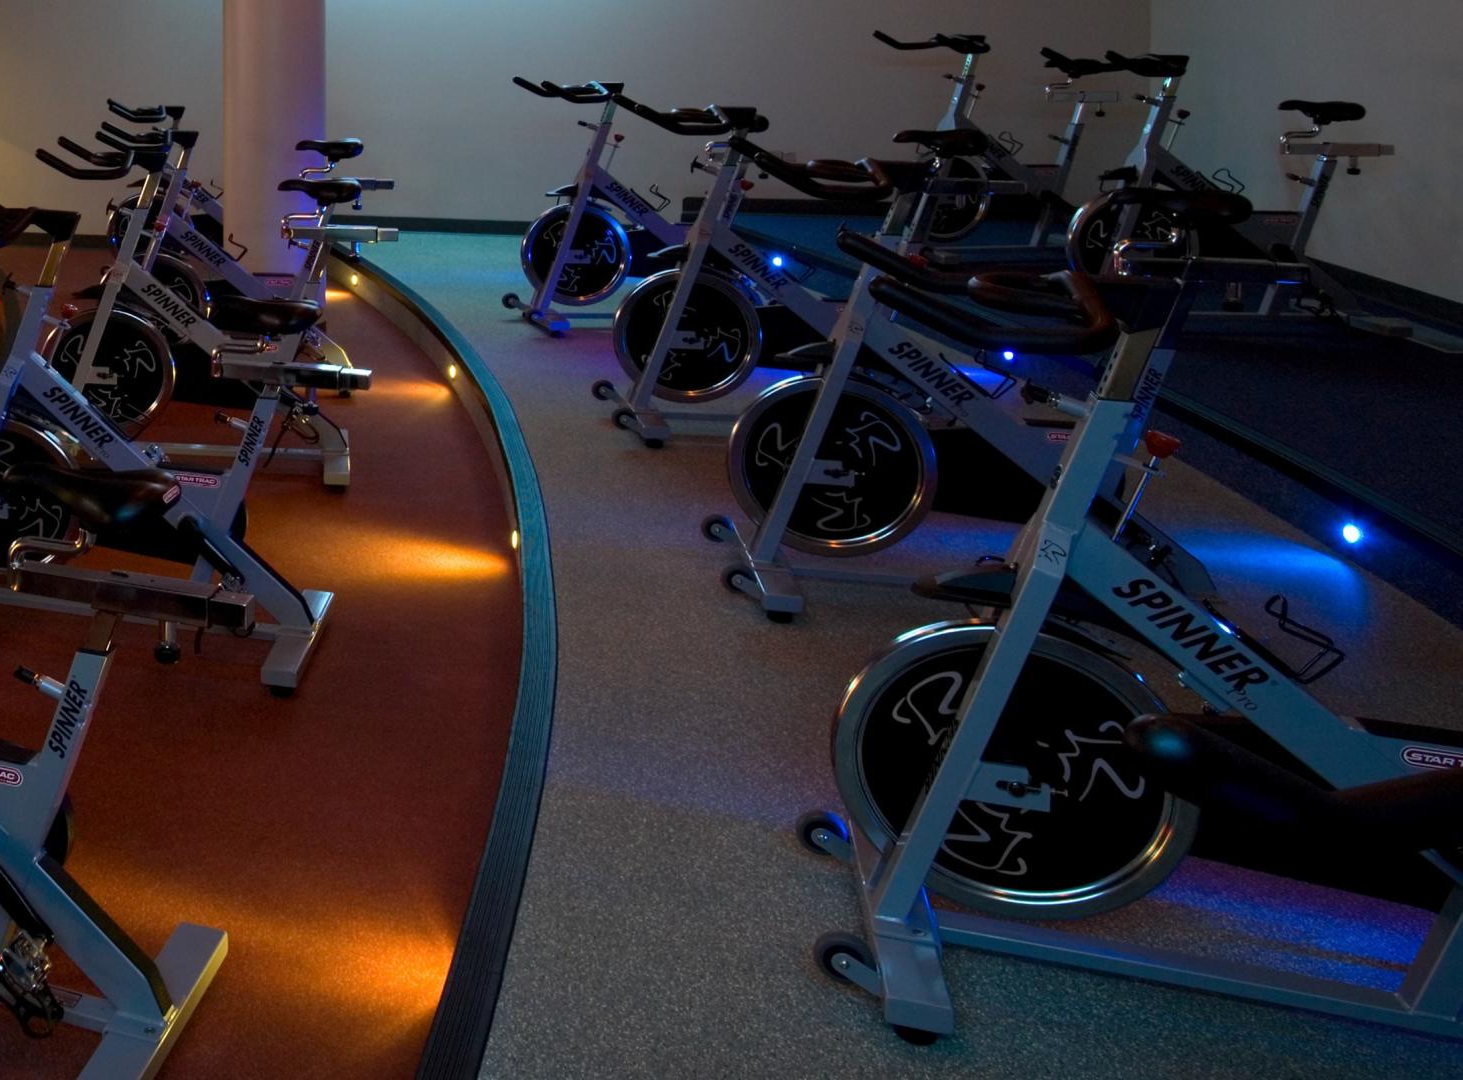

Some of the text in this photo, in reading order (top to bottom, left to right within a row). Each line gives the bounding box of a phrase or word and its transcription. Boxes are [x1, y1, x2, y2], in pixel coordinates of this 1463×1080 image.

[605, 181, 650, 217] SPINNER
[181, 230, 227, 268] SPINNER
[728, 243, 789, 290] SPINNER
[141, 283, 197, 328] SPINNER
[889, 341, 975, 406] SPINNER
[1130, 367, 1163, 422] SPINNER
[43, 386, 114, 448] SPINNER
[237, 415, 266, 467] SPINNER
[1112, 579, 1269, 691] SPINNER
[48, 679, 88, 759] SPINNER
[1410, 752, 1456, 766] STAR
